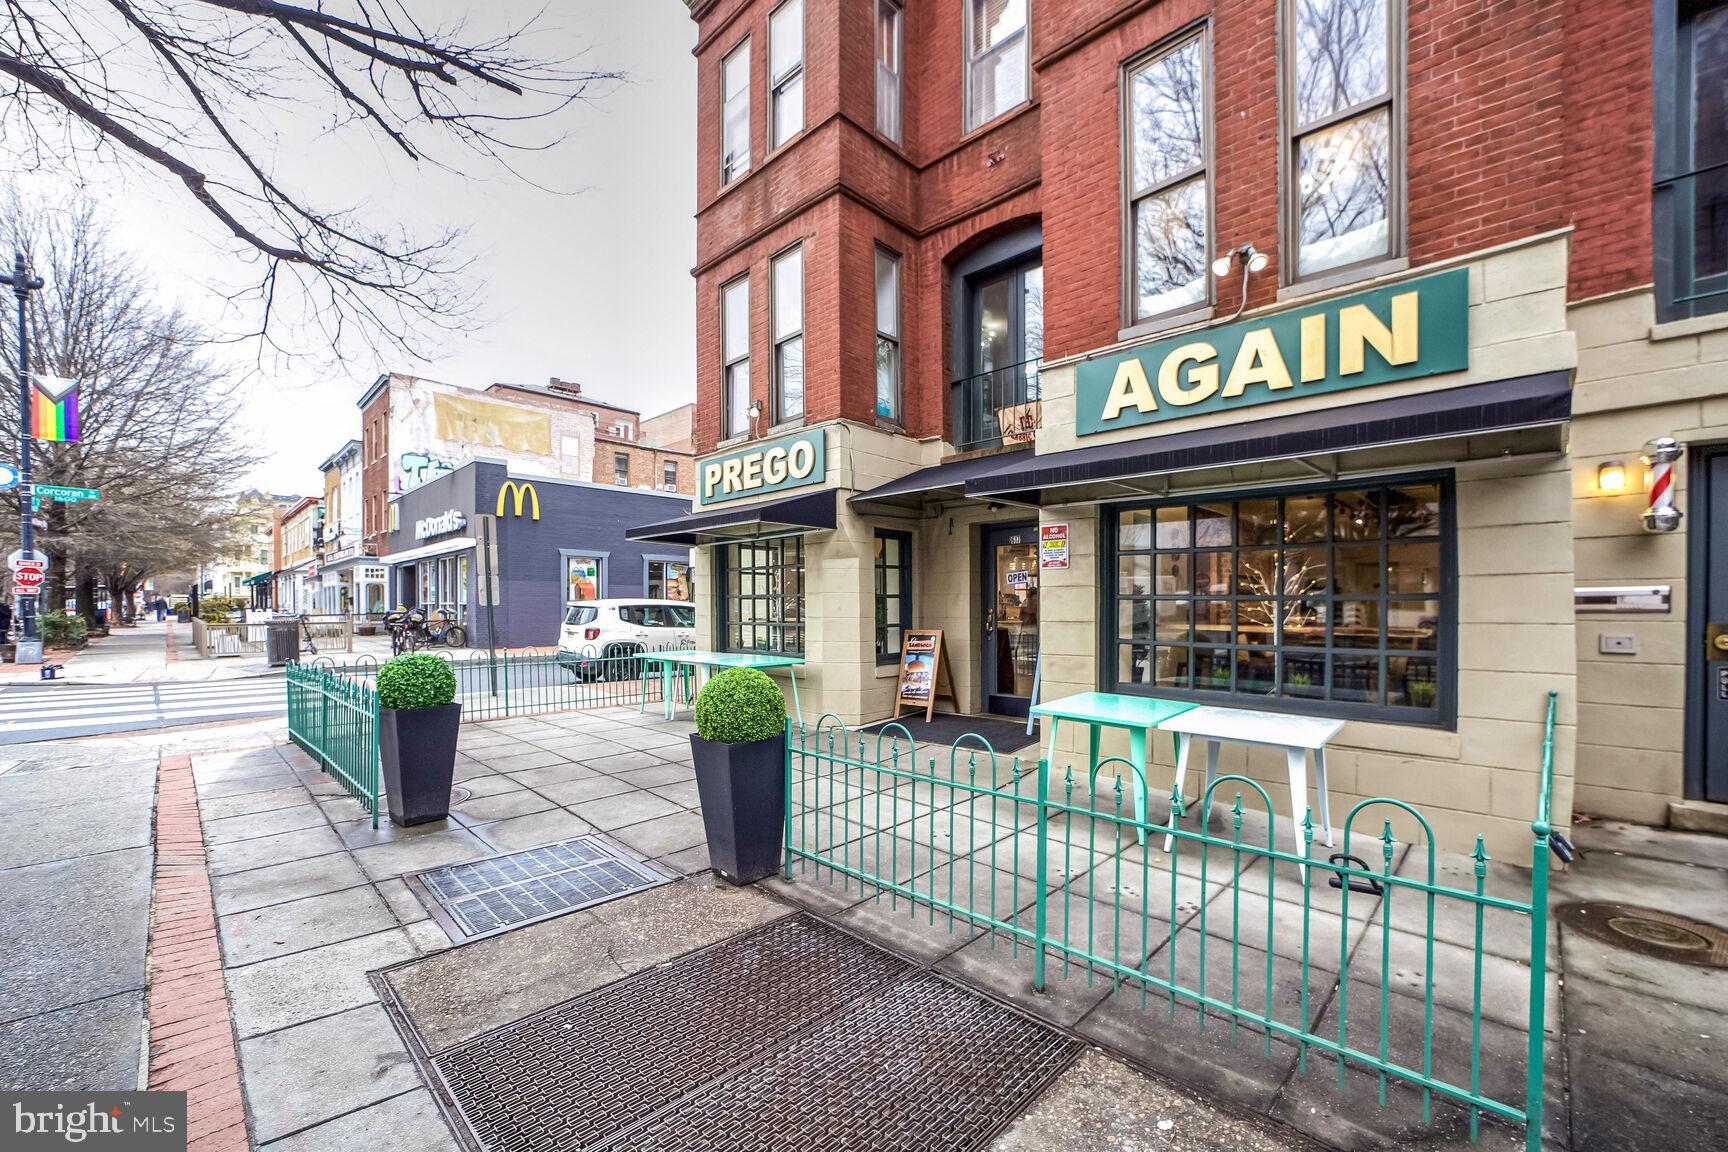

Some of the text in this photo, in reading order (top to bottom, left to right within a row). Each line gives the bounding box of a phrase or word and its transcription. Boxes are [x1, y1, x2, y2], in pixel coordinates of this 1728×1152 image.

[1100, 290, 1419, 421] AGAIN
[705, 440, 815, 498] PREGO
[36, 486, 84, 499] Corcoran
[415, 508, 464, 541] McDonald's
[16, 572, 44, 581] STOP
[1007, 572, 1027, 583] OPEN
